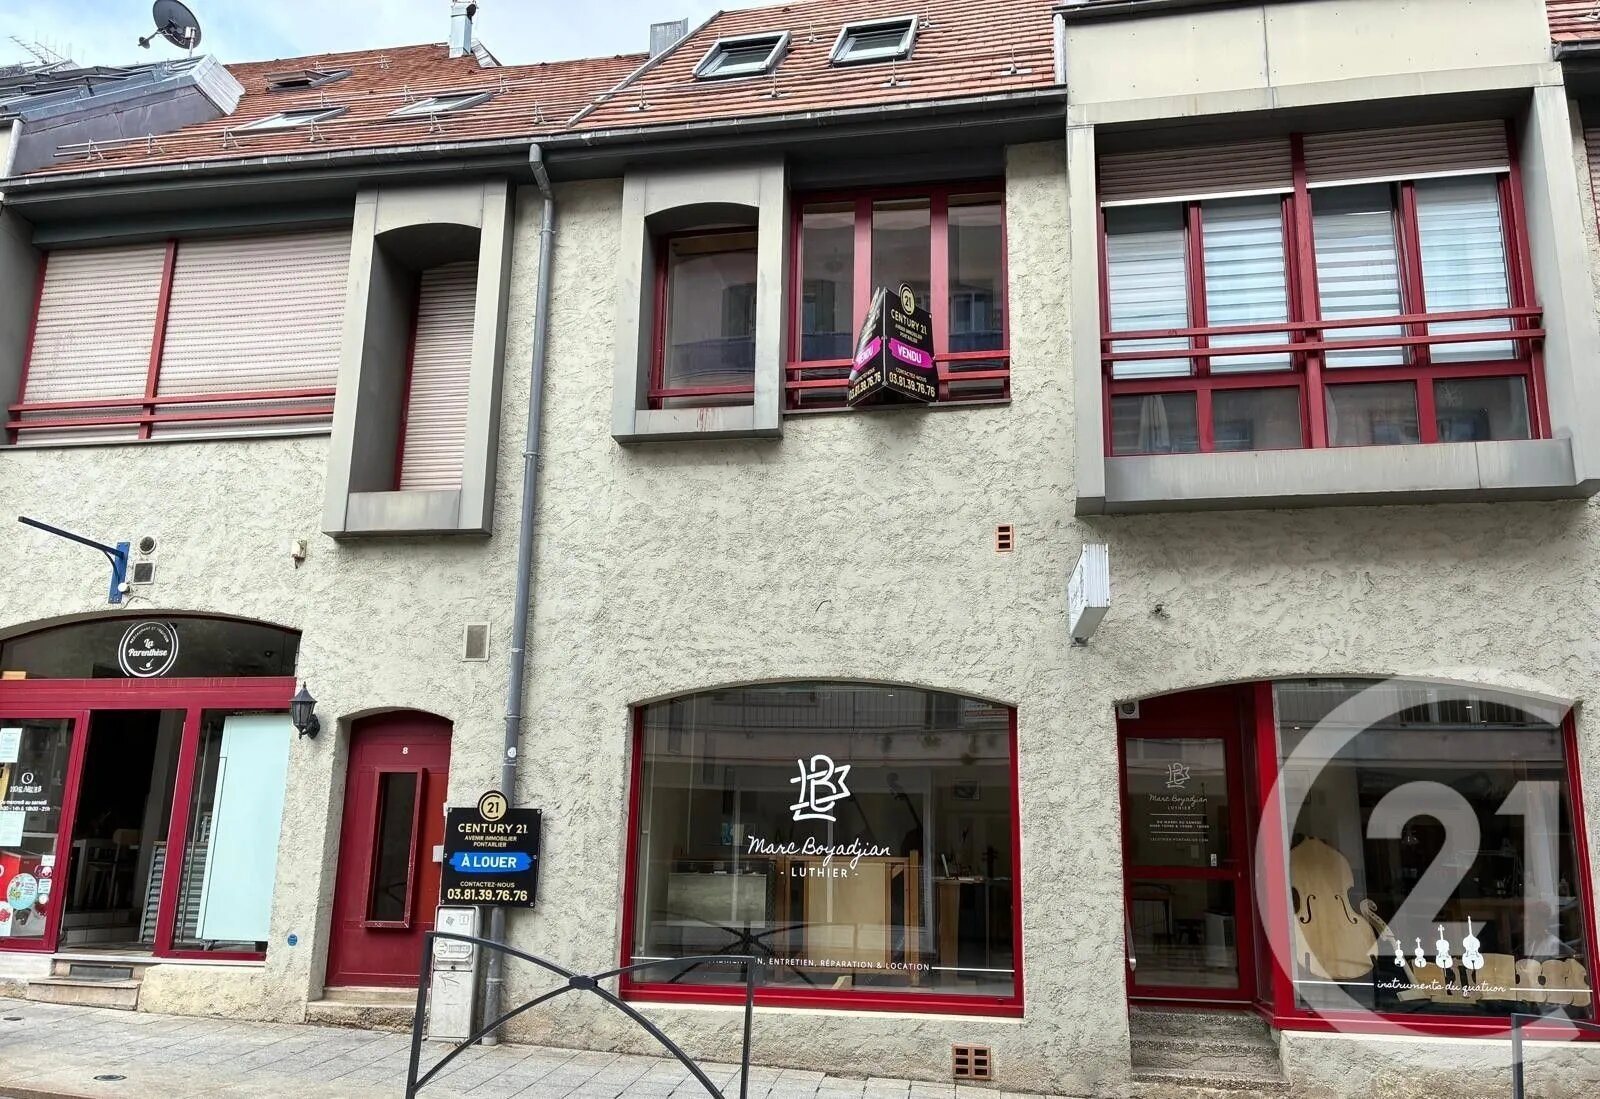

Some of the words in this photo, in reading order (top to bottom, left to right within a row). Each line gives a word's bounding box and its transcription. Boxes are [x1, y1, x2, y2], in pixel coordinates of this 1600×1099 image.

[891, 309, 920, 331] CENTURY
[920, 324, 927, 335] 21
[897, 344, 921, 363] VENDU
[889, 371, 935, 398] 03.81.39.76.76
[143, 638, 154, 649] La
[128, 648, 168, 657] Parenthèse
[402, 746, 409, 755] 8
[487, 801, 499, 814] 21
[457, 824, 513, 834] CENTURY
[516, 824, 528, 834] 21
[747, 836, 801, 854] Marc
[802, 836, 891, 870] Boyadjian
[461, 853, 471, 867] À
[474, 856, 517, 868] LOUER
[791, 867, 848, 878] LUTHIER
[447, 888, 528, 901] 03.81.39.76.76
[769, 958, 817, 967] ENTRETIEN,
[820, 958, 873, 968] RÉPARATION
[876, 961, 882, 969] &
[885, 962, 930, 971] LOCATION
[1377, 977, 1444, 990] instruments
[1445, 980, 1460, 991] du
[1462, 980, 1507, 996] quatuor
